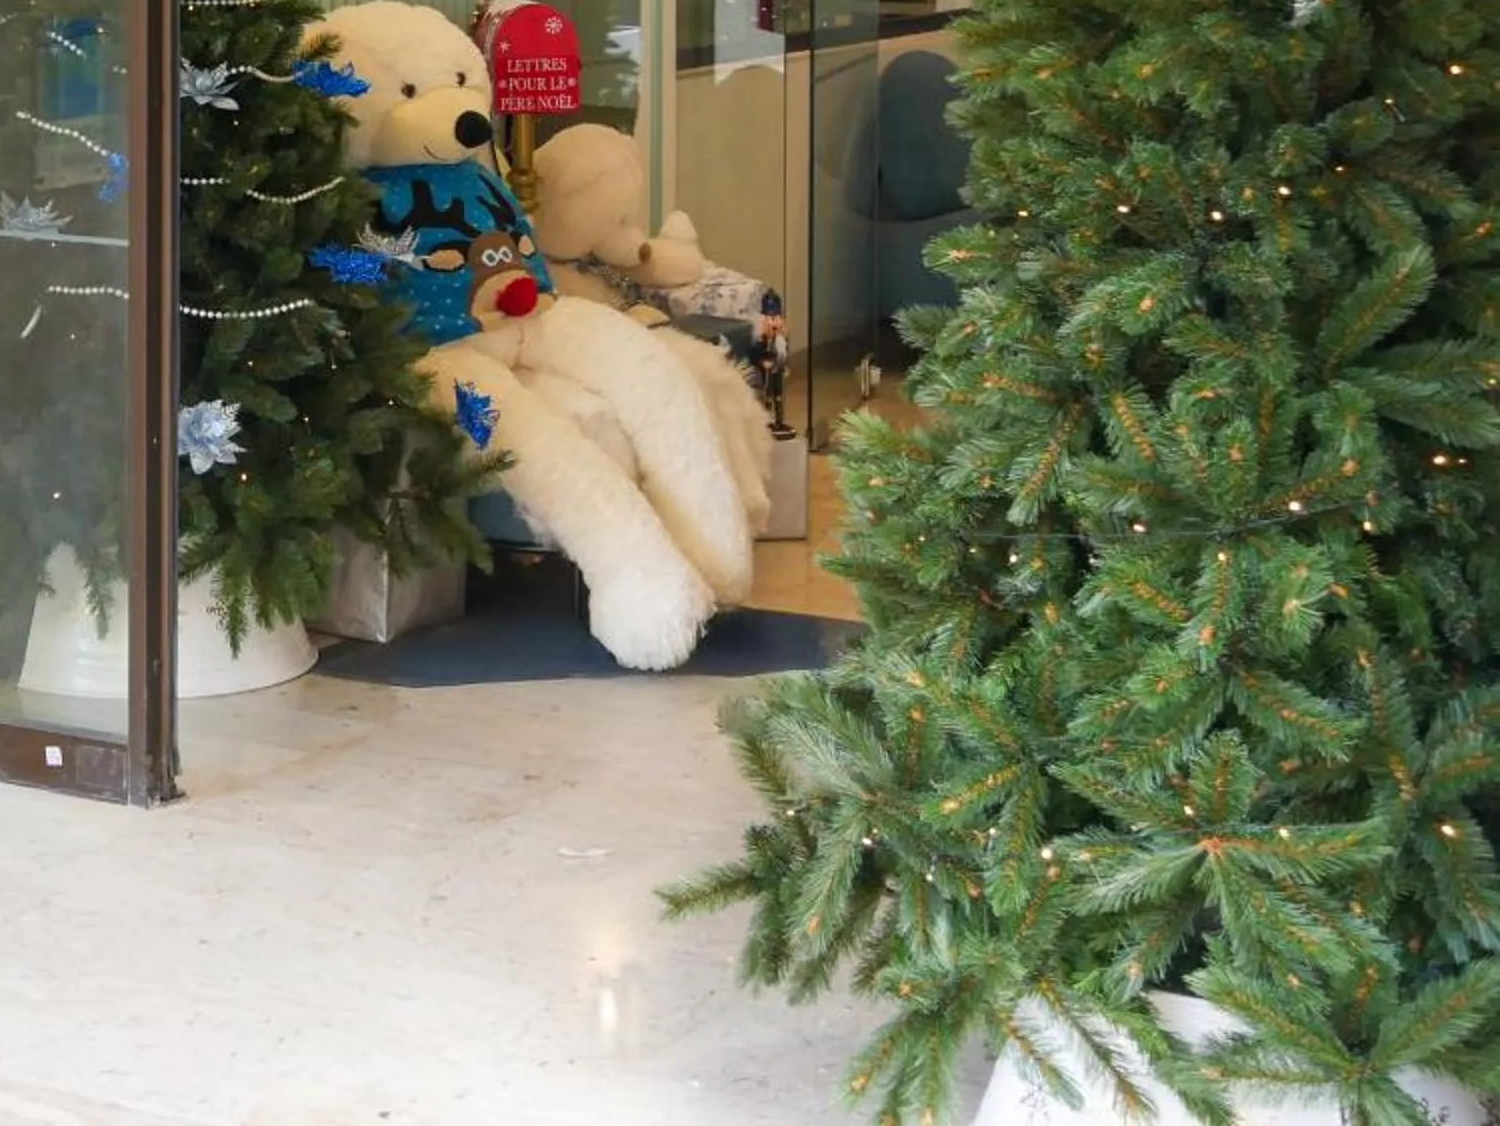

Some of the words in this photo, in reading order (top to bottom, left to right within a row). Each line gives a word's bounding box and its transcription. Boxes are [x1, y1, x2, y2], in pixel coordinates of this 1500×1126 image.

[507, 57, 567, 73] LETTRES
[509, 77, 546, 91] POUR
[550, 76, 567, 91] LE
